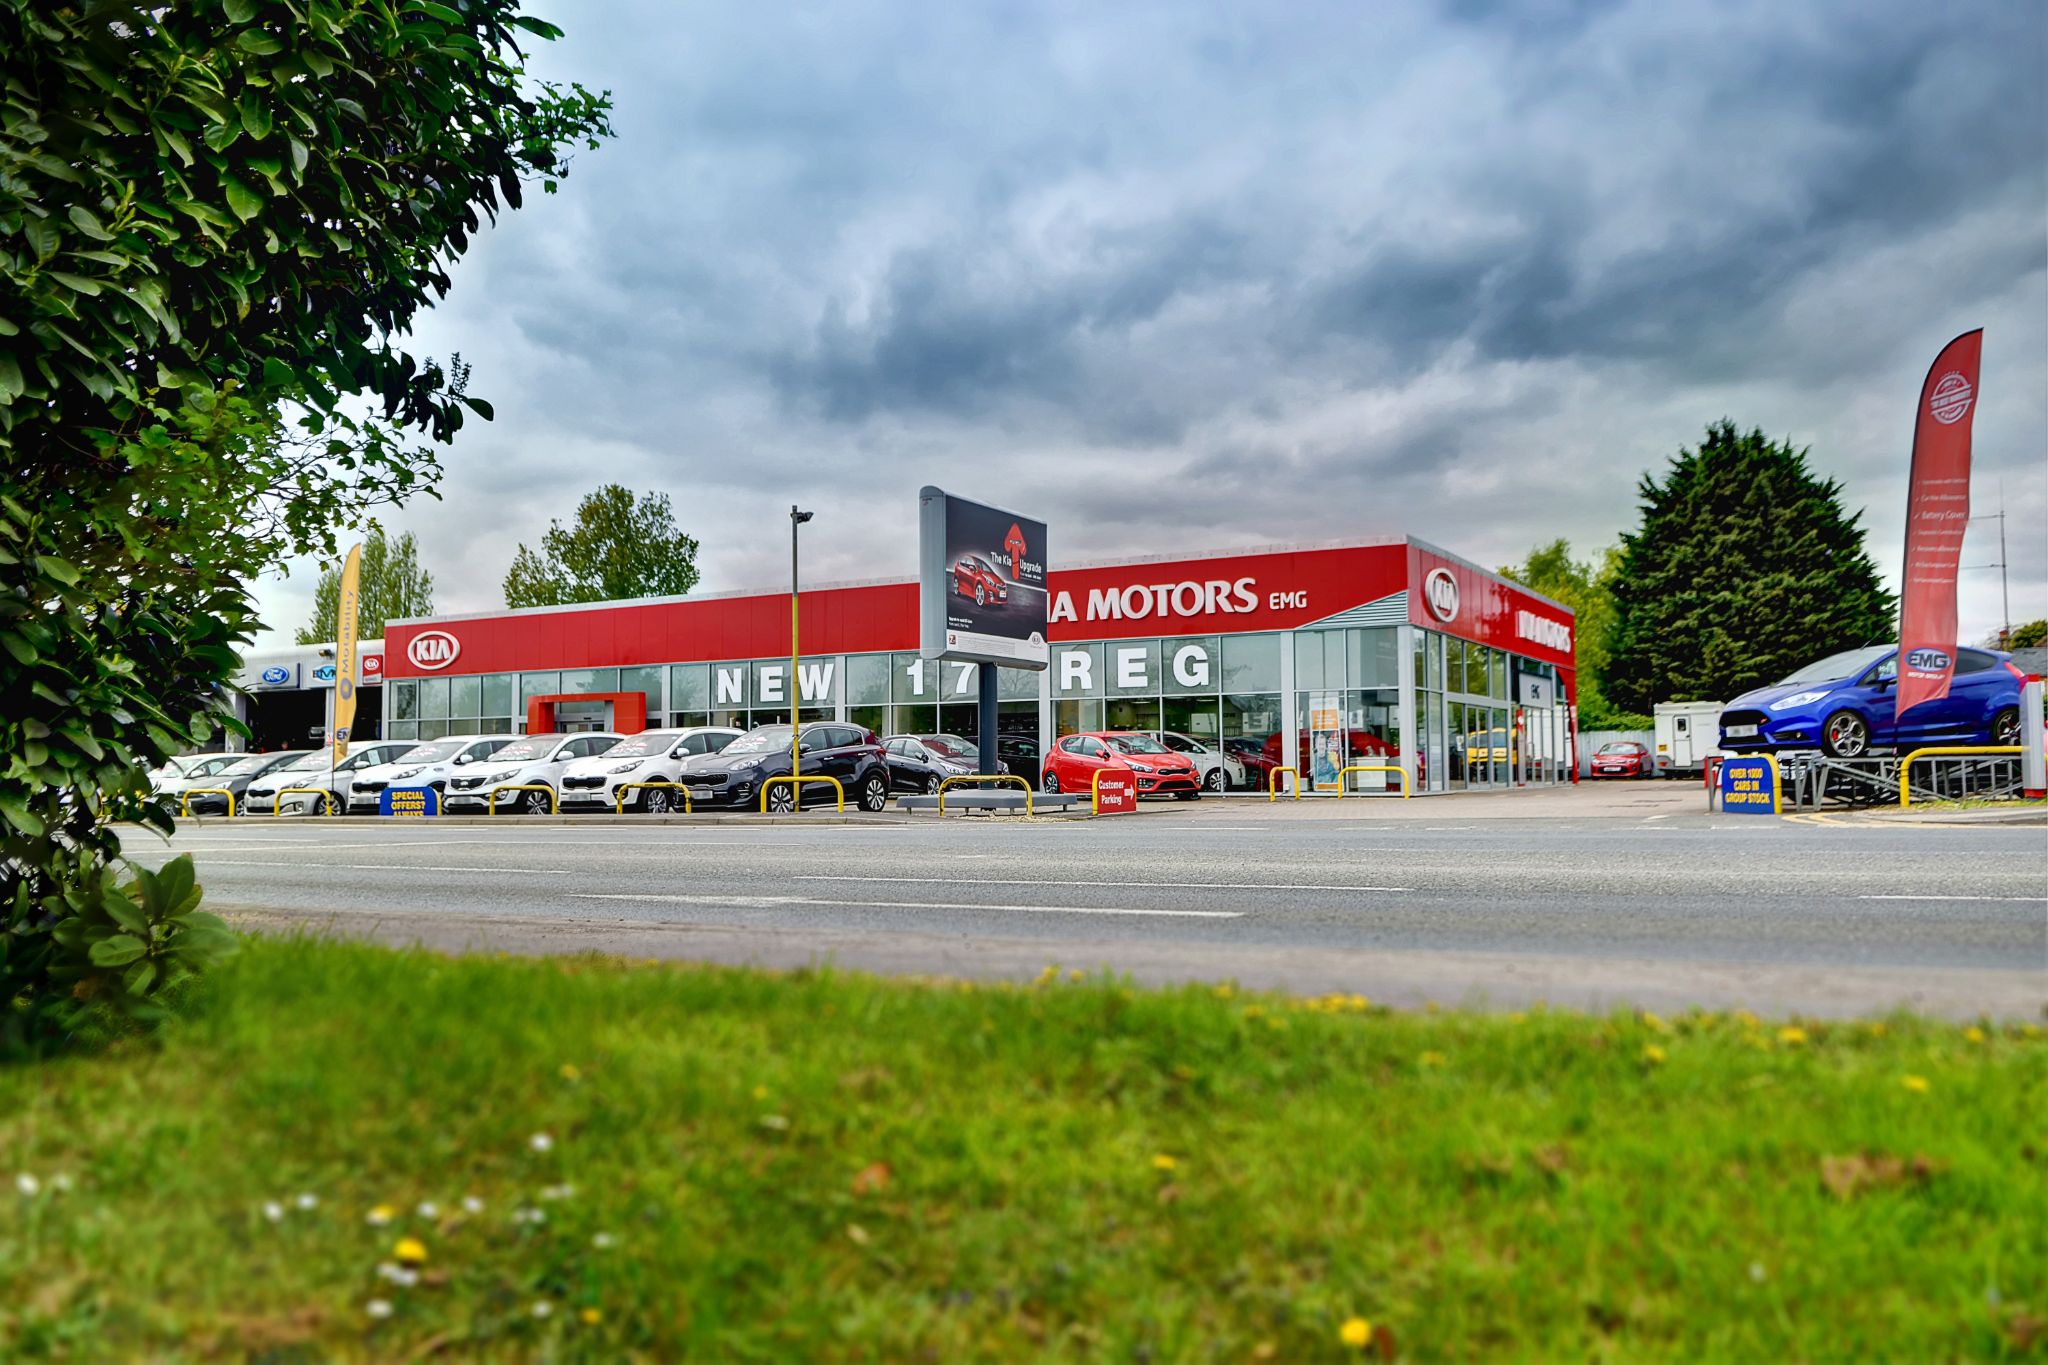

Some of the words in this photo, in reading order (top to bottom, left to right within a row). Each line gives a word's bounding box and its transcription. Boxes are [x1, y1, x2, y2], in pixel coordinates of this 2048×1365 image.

[990, 551, 1002, 564] The
[1003, 554, 1012, 567] Kia
[1020, 558, 1042, 574] Upgrade
[1086, 577, 1259, 620] MOTORS
[1269, 591, 1307, 609] EMG
[1908, 652, 1948, 668] EMG
[717, 663, 835, 704] NEW
[907, 659, 977, 696] 17
[1060, 645, 1209, 690] REG
[1098, 780, 1125, 790] Customer
[391, 791, 425, 800] SPECIAL
[1101, 794, 1122, 806] Parking
[390, 801, 426, 810] OFFERS?
